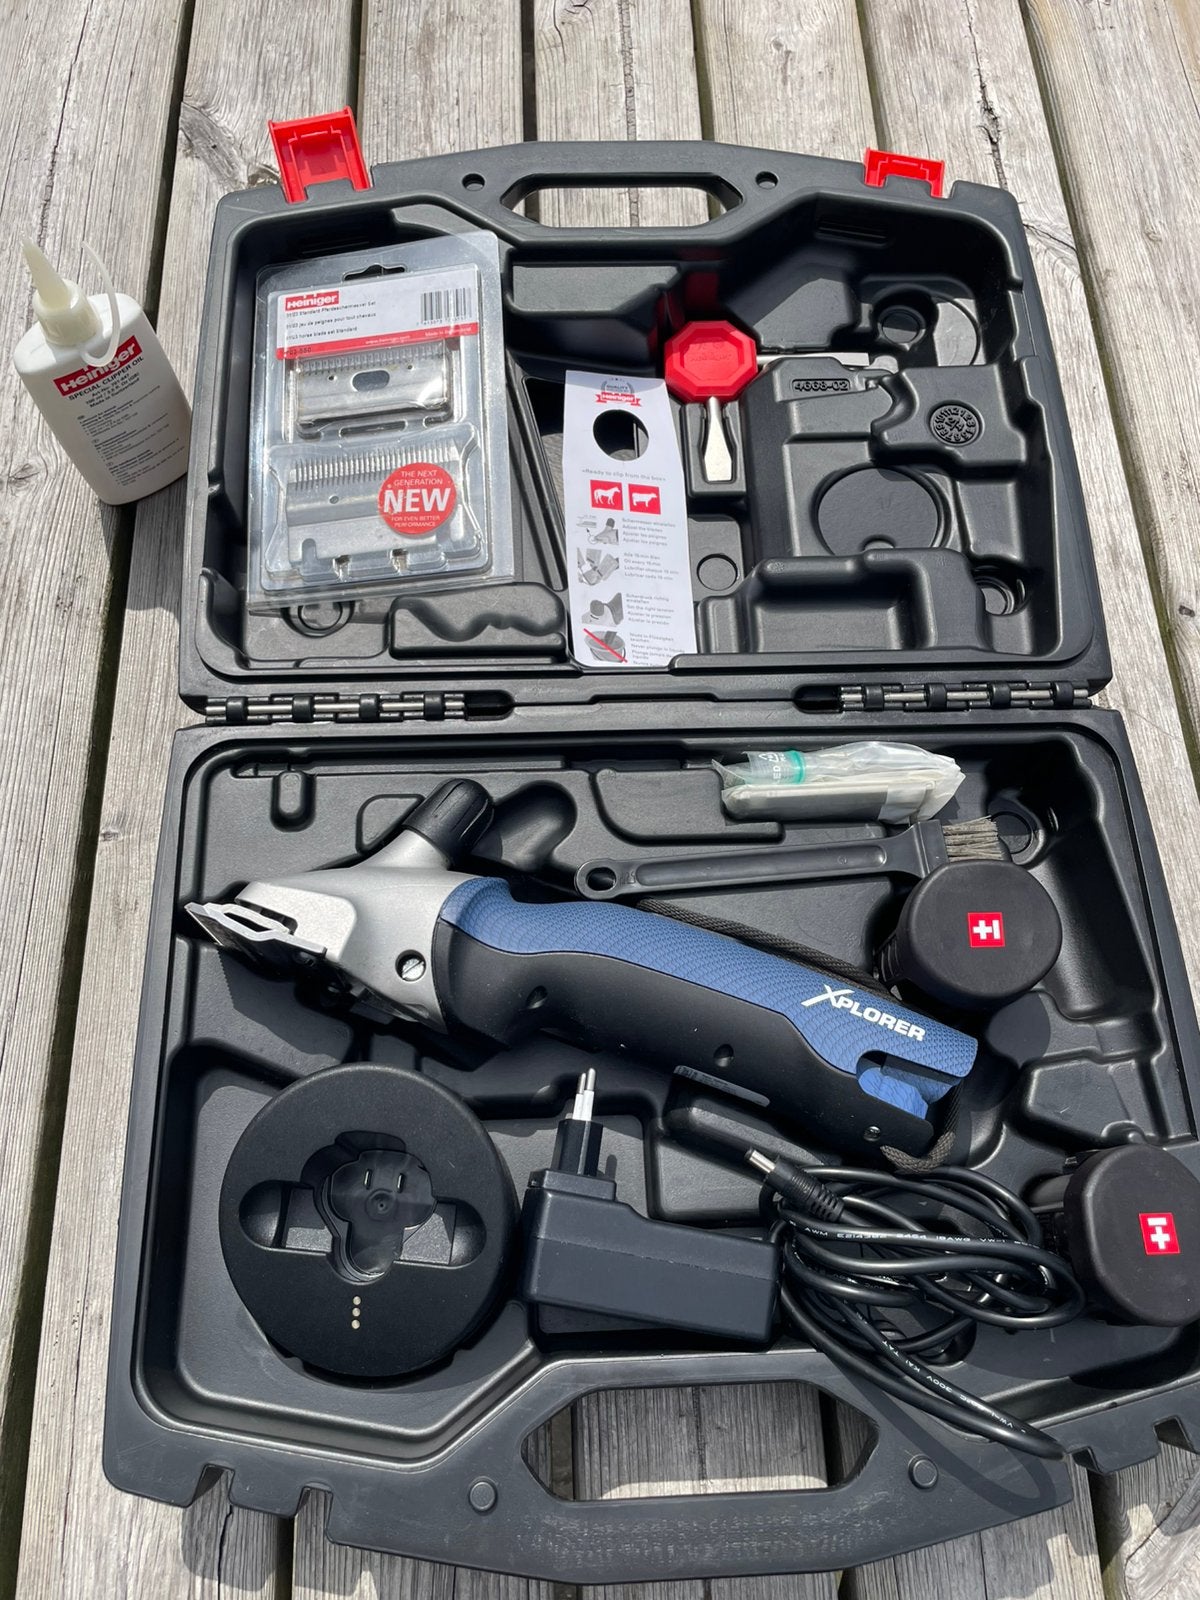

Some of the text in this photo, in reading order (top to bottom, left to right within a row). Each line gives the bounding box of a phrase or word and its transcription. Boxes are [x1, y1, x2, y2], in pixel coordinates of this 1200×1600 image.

[287, 293, 338, 309] Heiniger
[60, 343, 135, 392] Heiniger
[68, 356, 144, 401] SPECIAL CLIPPER OIL
[417, 469, 438, 477] NEXT
[393, 478, 444, 487] GENERATION
[383, 487, 451, 513] NEW
[801, 984, 926, 1042] XPLORER
[805, 1227, 828, 1236] AWM
[926, 1375, 953, 1393] 300V
